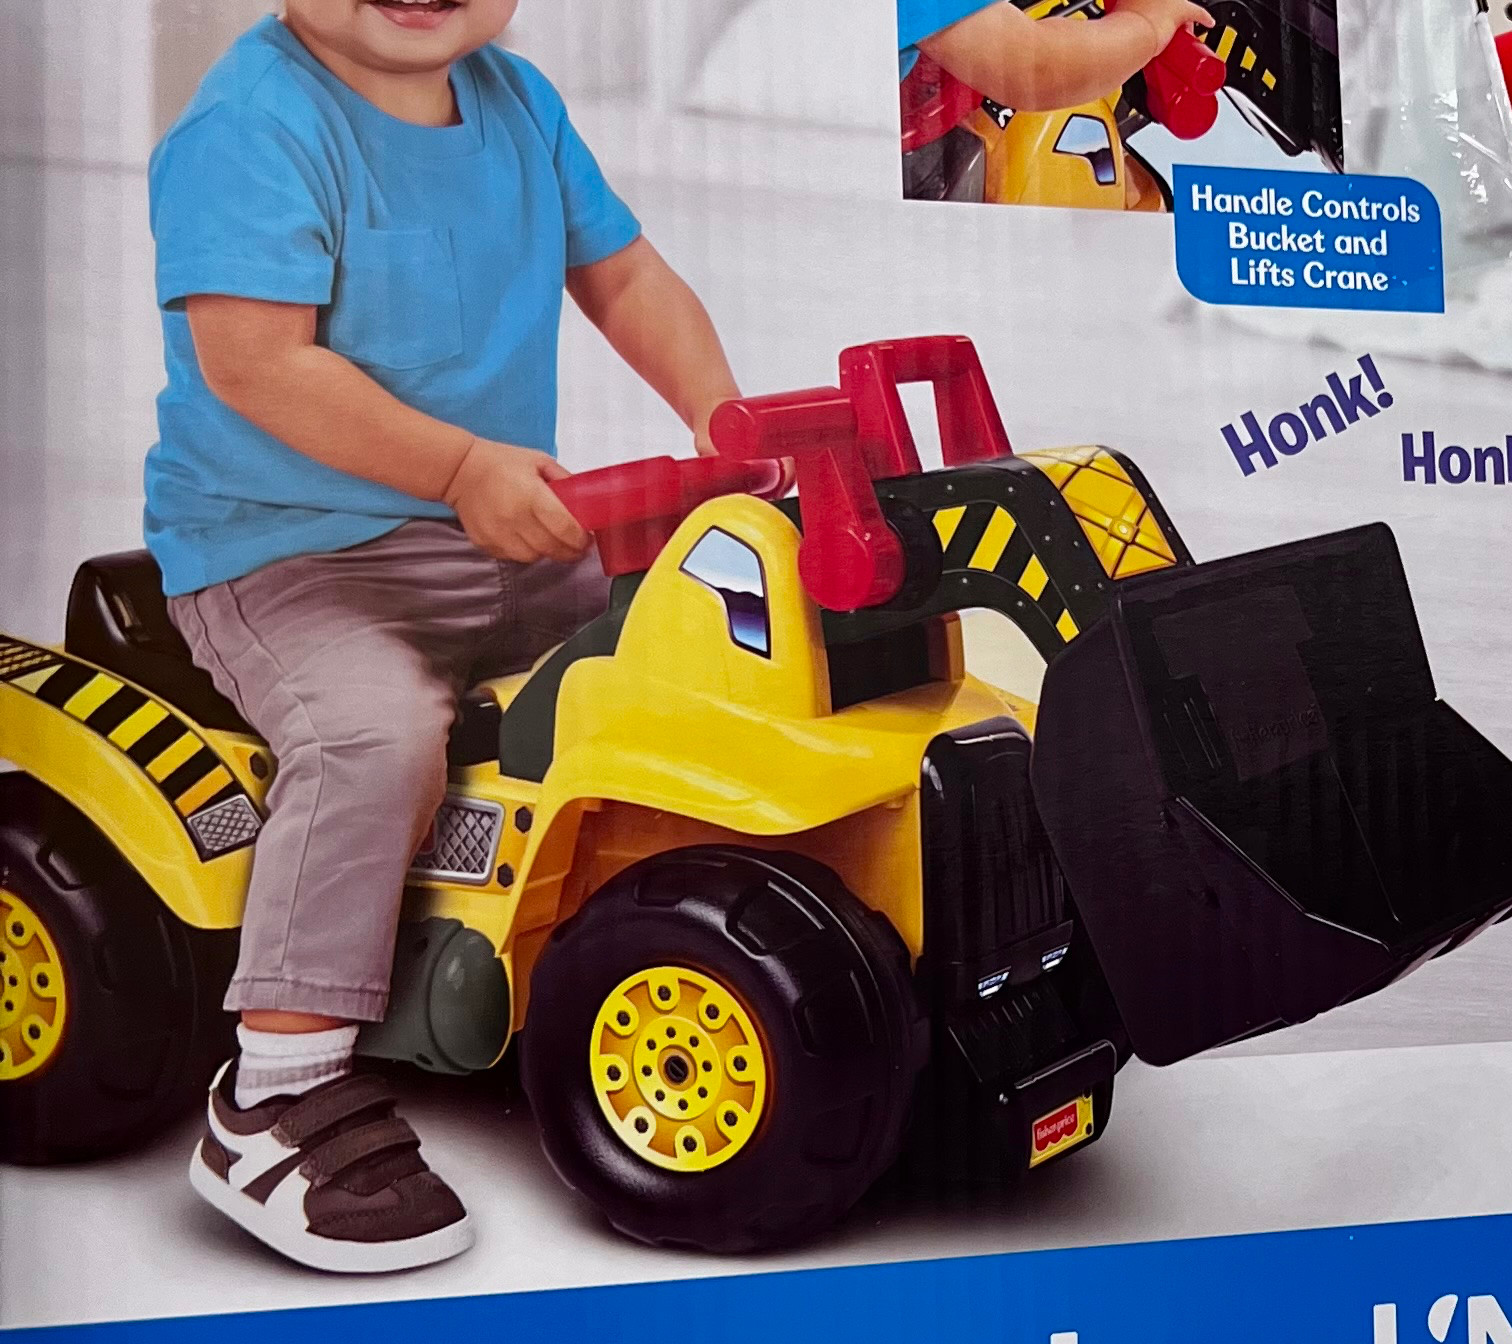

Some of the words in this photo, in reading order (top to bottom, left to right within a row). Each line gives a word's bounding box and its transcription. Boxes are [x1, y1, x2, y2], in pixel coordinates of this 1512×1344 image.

[1191, 183, 1293, 217] Handle
[1301, 189, 1421, 224] Controls
[1228, 221, 1326, 255] Bucket
[1333, 229, 1388, 257] and
[1230, 256, 1295, 288] Lifts
[1303, 261, 1389, 292] Crane
[1220, 352, 1395, 478] Honk!
